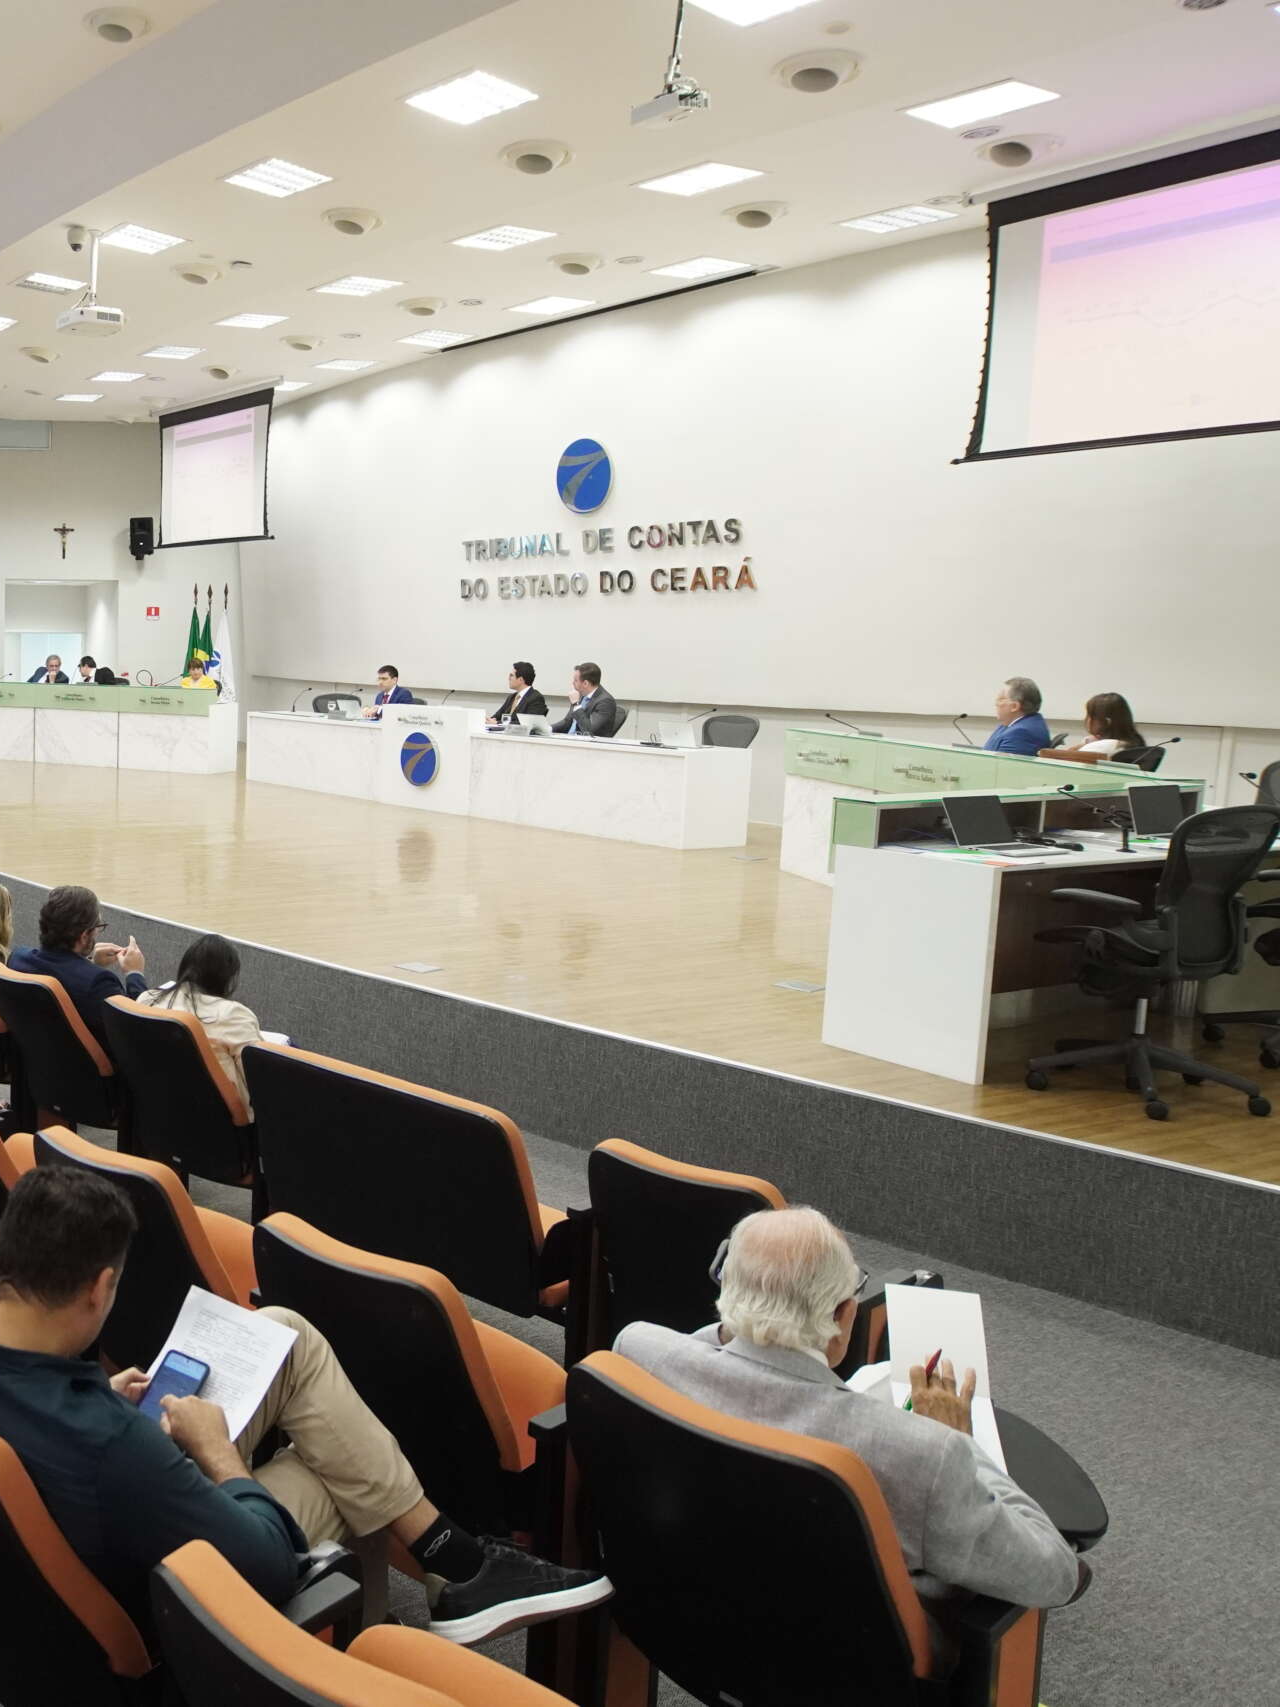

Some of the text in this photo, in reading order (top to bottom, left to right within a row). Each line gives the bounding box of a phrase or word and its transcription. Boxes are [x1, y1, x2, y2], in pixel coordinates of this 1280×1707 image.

[462, 518, 743, 562] TRIBUNAL DE CONTAS
[460, 556, 758, 600] DO ESTADO DO CEARÁ
